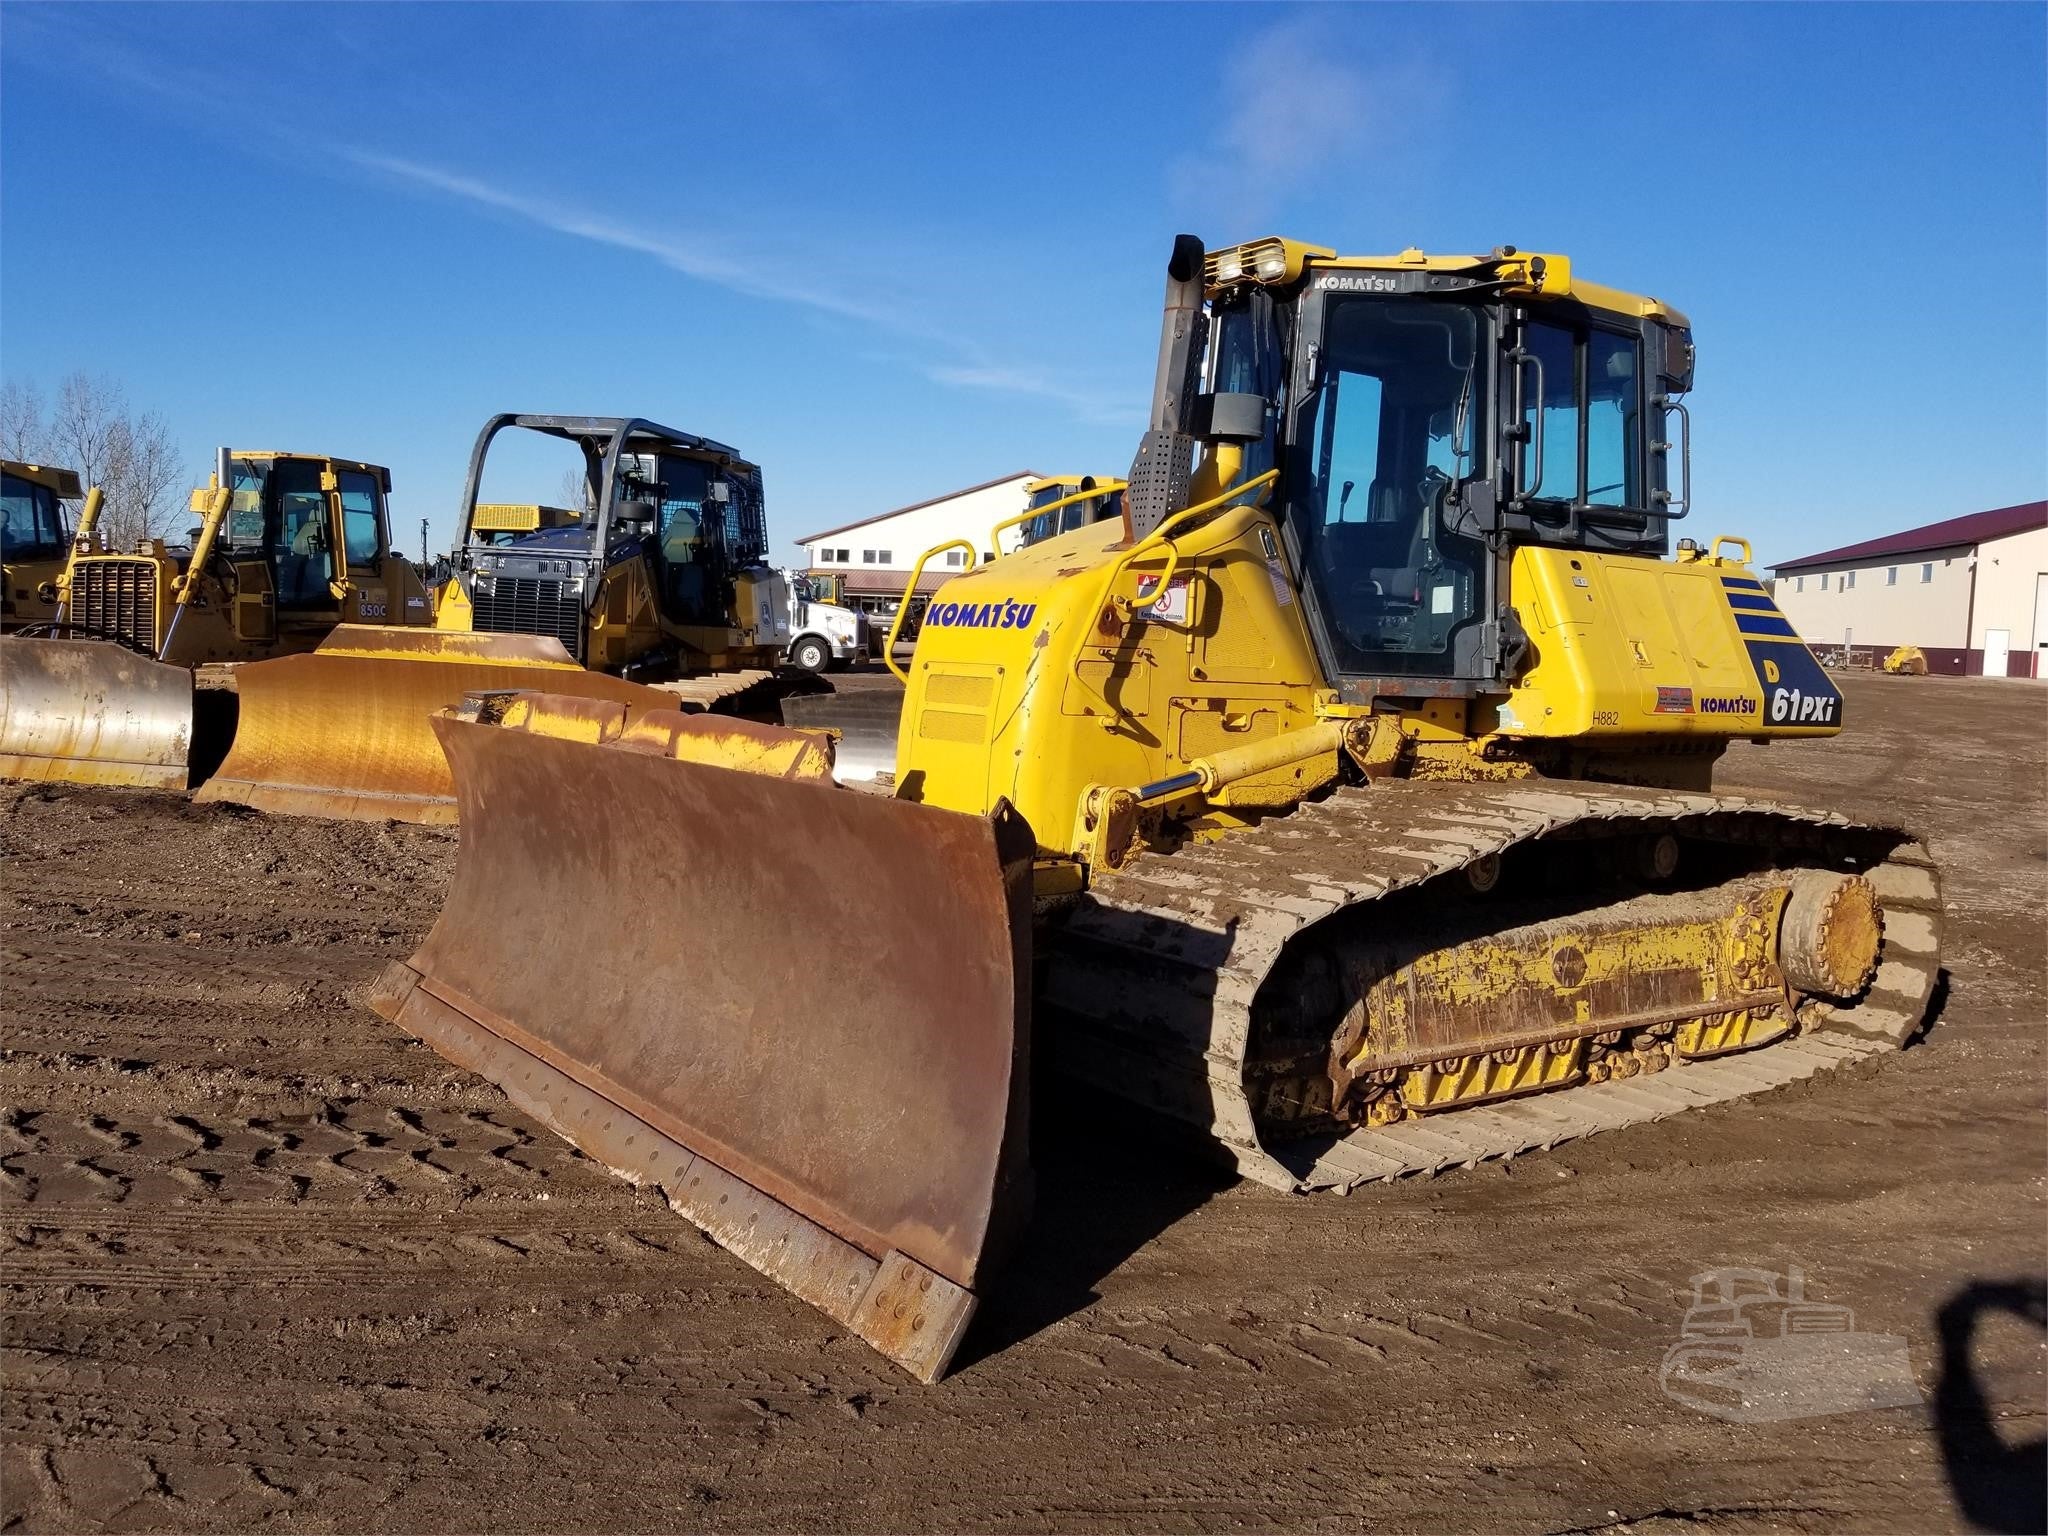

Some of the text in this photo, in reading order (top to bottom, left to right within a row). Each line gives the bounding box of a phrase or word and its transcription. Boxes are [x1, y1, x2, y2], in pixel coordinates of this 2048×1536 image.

[1314, 275, 1396, 292] KOMATSU
[360, 604, 387, 617] 850C
[925, 597, 1037, 630] KOMATSU
[1763, 659, 1780, 683] D
[1700, 694, 1757, 714] KOMATSU
[1771, 687, 1835, 722] 61PXi
[1592, 710, 1619, 726] H882
